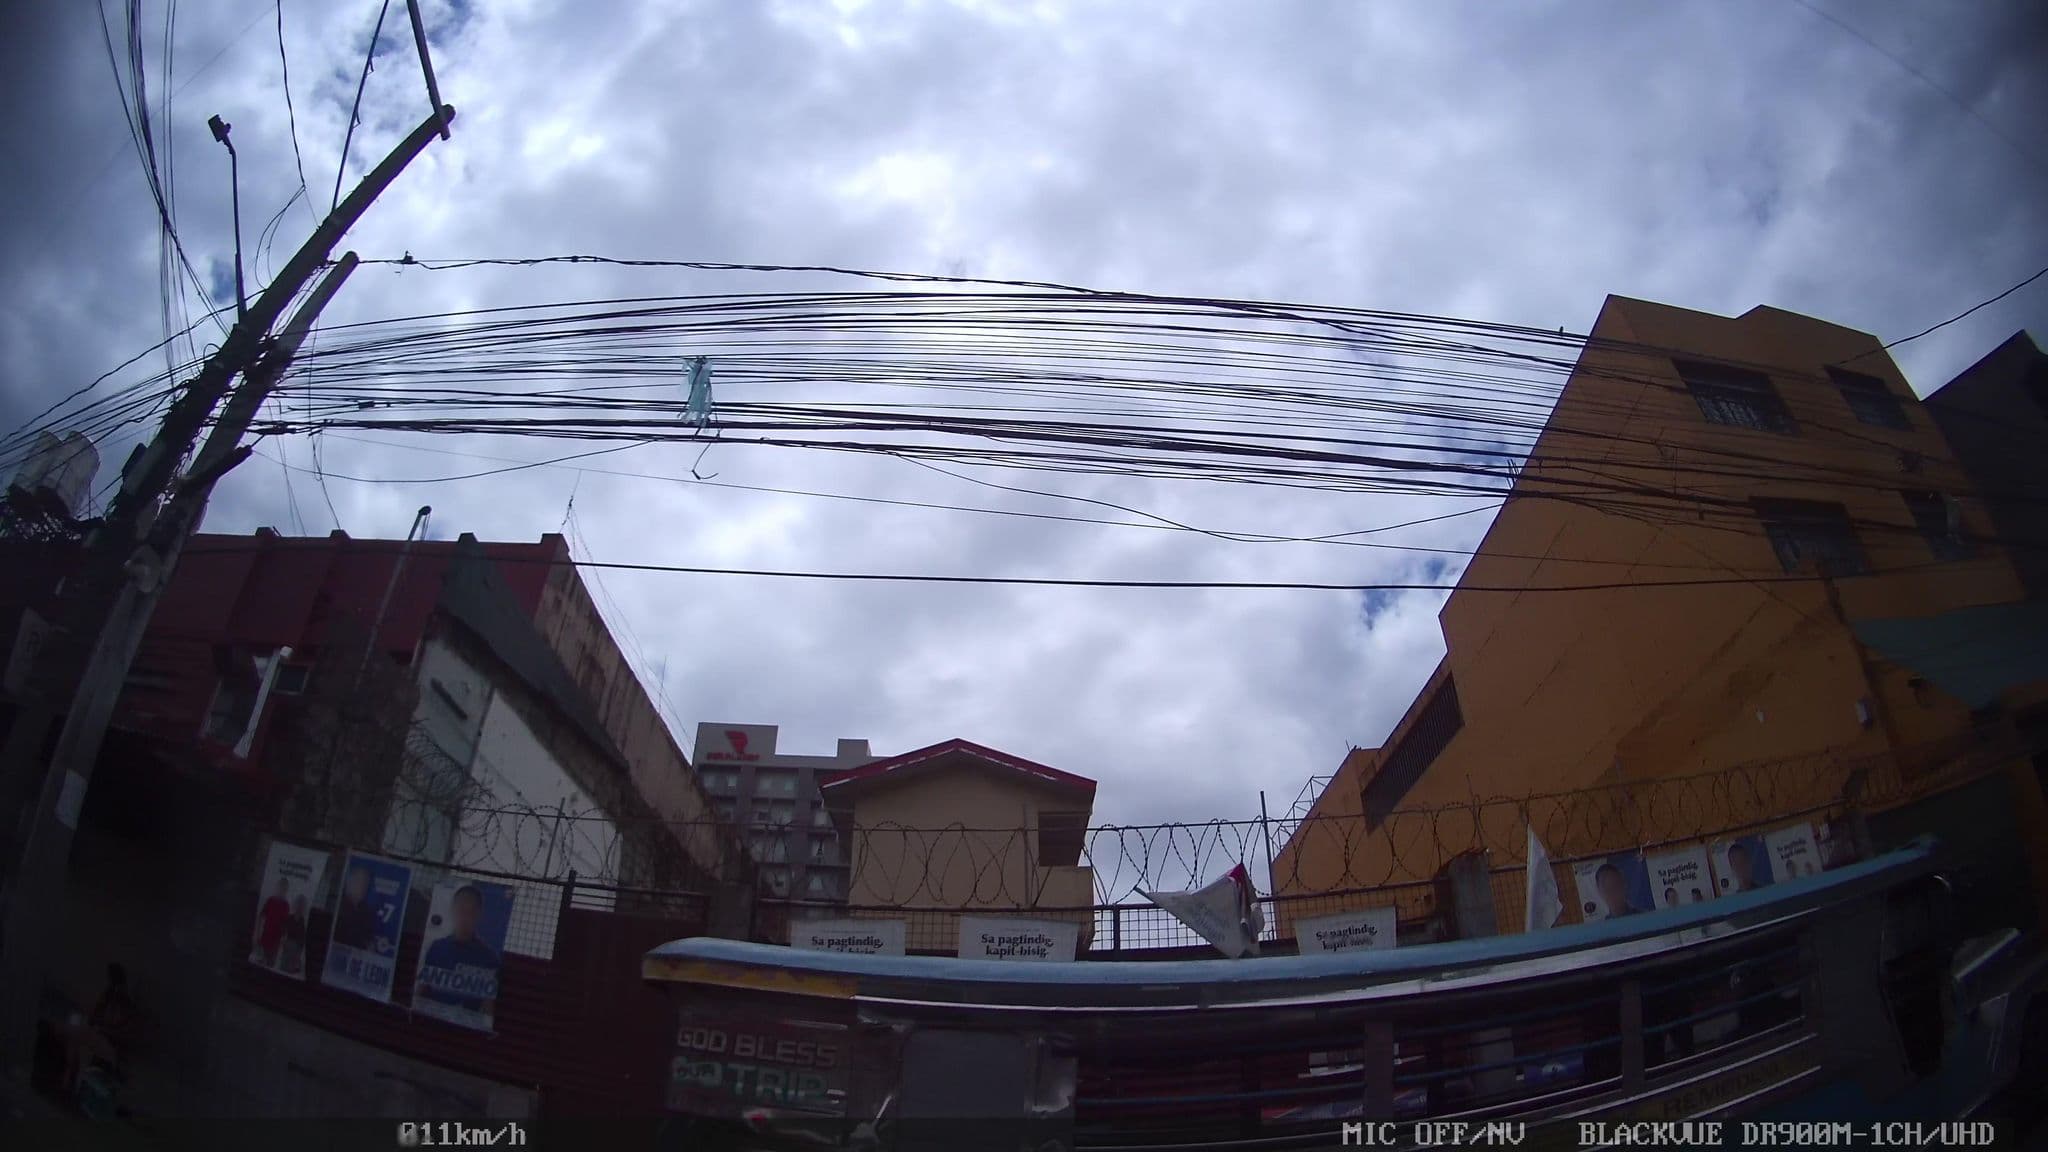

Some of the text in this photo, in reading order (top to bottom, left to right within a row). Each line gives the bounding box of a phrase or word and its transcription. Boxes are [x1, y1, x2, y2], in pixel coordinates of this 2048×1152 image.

[812, 935, 883, 948] Sa pagtindig,
[981, 933, 1054, 947] Sa pagtindig,
[418, 966, 498, 995] ANTONIO
[677, 1026, 838, 1067] GOD BLESS
